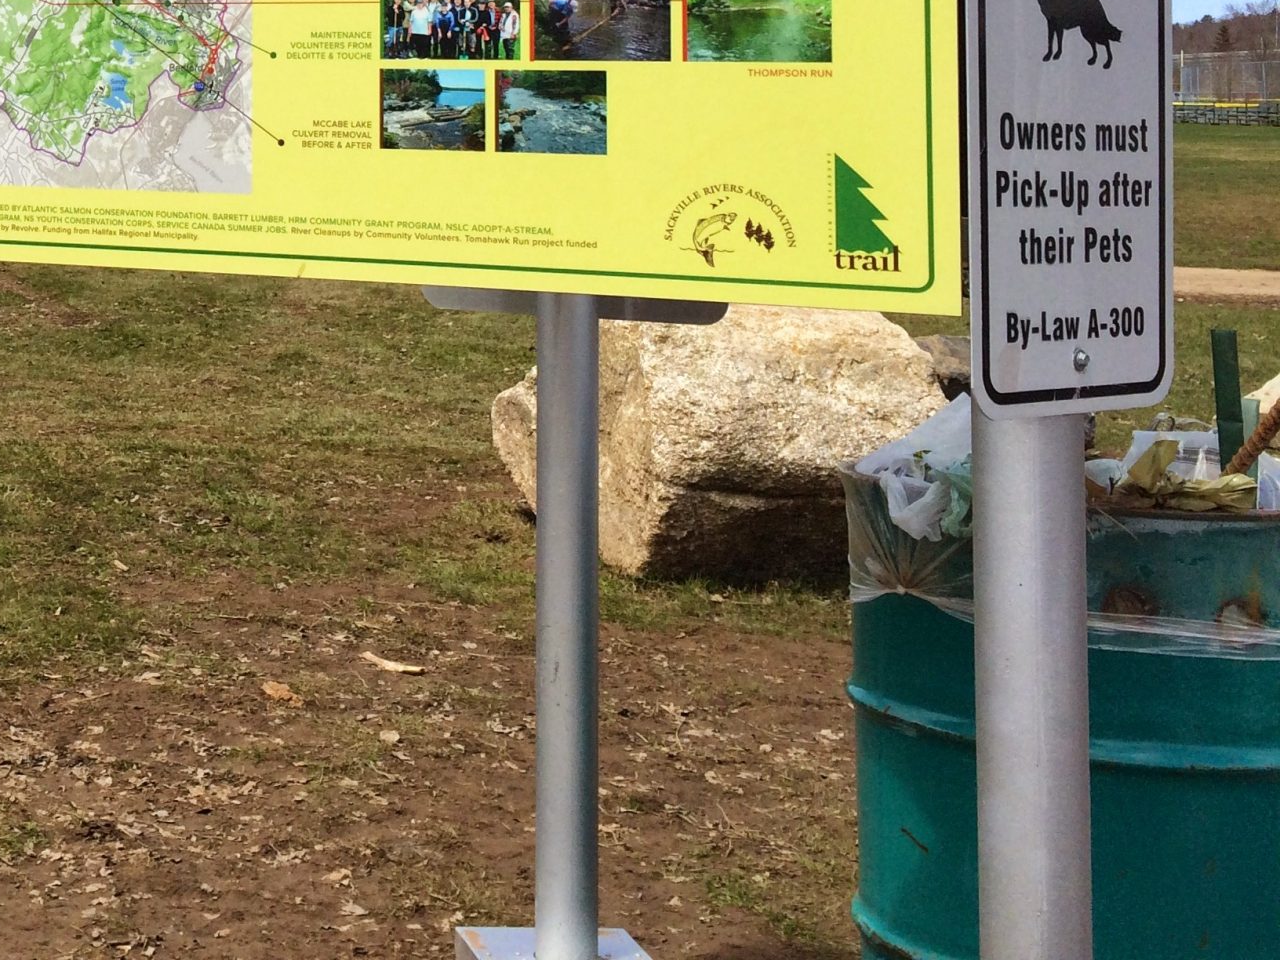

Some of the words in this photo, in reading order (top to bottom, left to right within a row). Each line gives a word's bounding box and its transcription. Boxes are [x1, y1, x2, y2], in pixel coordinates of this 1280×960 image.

[310, 31, 372, 39] MAINTENANCE
[290, 41, 345, 49] VOLUNTEERS
[347, 41, 372, 49] FROM
[286, 51, 326, 59] DELOITTE
[336, 51, 372, 60] TOUCHE
[747, 68, 807, 77] THOMPSON
[810, 69, 832, 77] RUN
[313, 120, 348, 128] MCCABE
[350, 120, 372, 128] LAKE
[292, 129, 329, 137] CULVERT
[331, 130, 372, 138] REMOVAL
[1000, 112, 1085, 151] Owners
[1096, 118, 1148, 152] must
[301, 140, 334, 148] BEFORE
[345, 141, 372, 149] AFTER
[996, 171, 1089, 215] Pick-Up
[1099, 172, 1152, 208] after
[664, 191, 702, 242] SACKVILLE
[703, 184, 744, 194] RIVERS
[746, 189, 796, 248] ASSOCIATION
[1020, 229, 1074, 265] their
[1085, 228, 1132, 263] Pets
[834, 245, 901, 272] trail
[1007, 311, 1080, 349] By-Law
[1087, 306, 1144, 339] A-300
